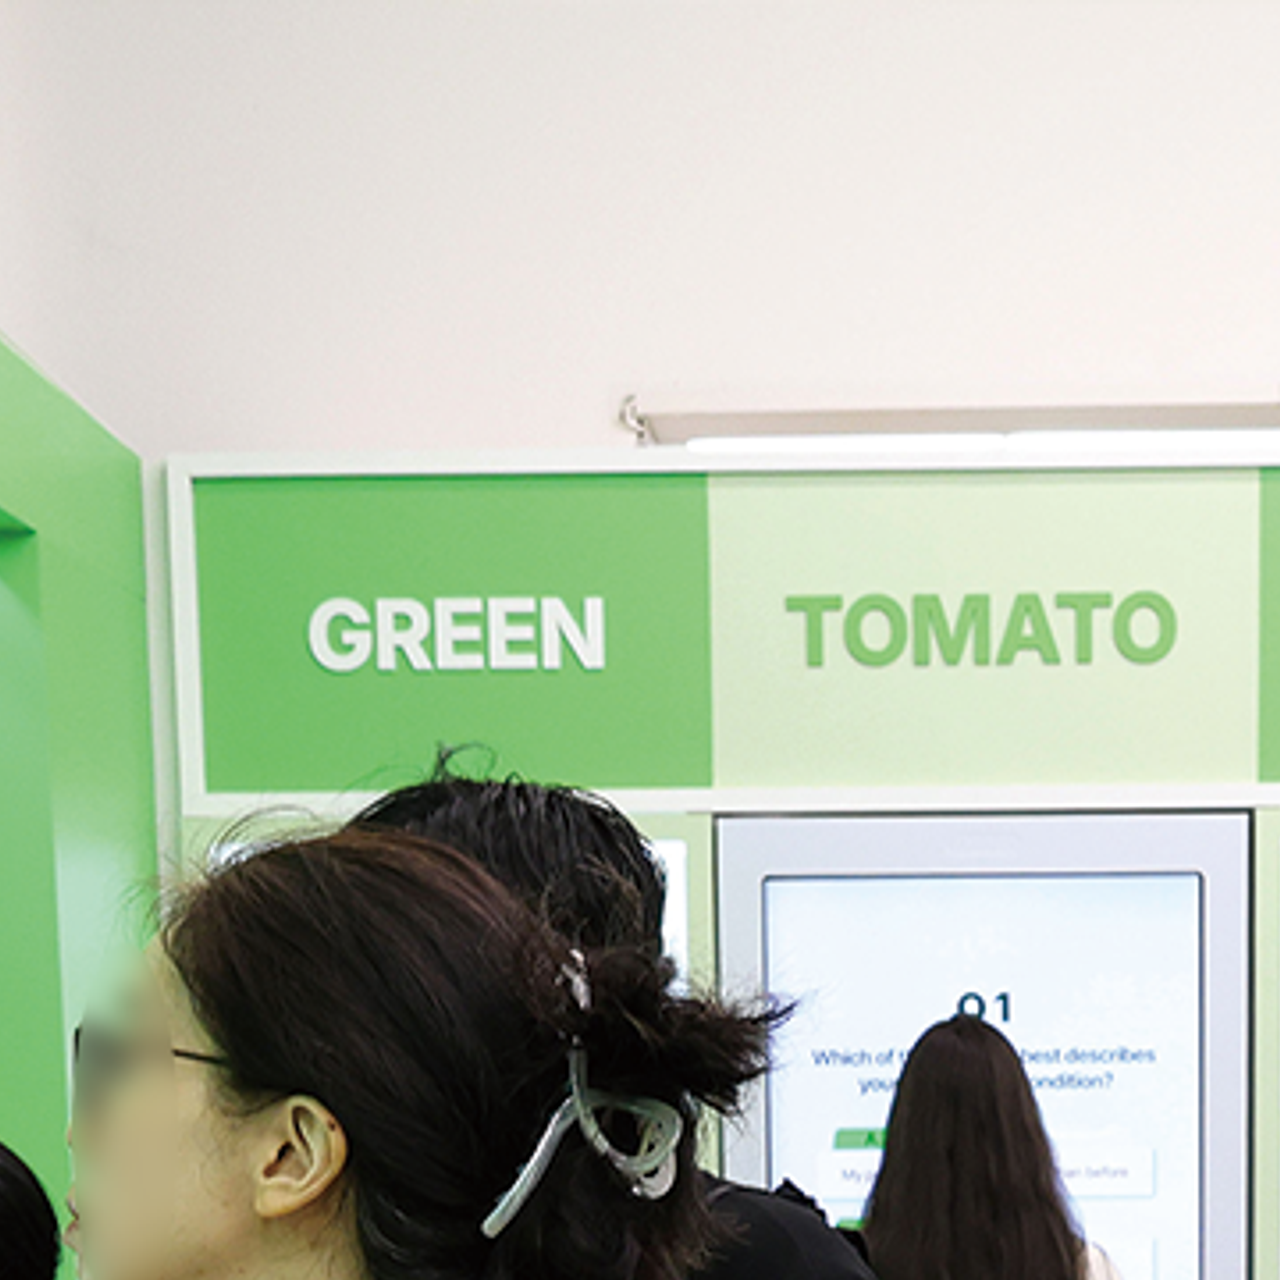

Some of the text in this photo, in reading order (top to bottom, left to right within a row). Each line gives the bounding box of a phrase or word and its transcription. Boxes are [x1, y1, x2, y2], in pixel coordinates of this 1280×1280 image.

[308, 596, 606, 672] GREEN
[785, 590, 1178, 668] TOMATO
[811, 1049, 872, 1067] Which
[875, 1049, 895, 1066] of
[1064, 1045, 1156, 1064] describes
[1030, 1071, 1114, 1089] ondition?
